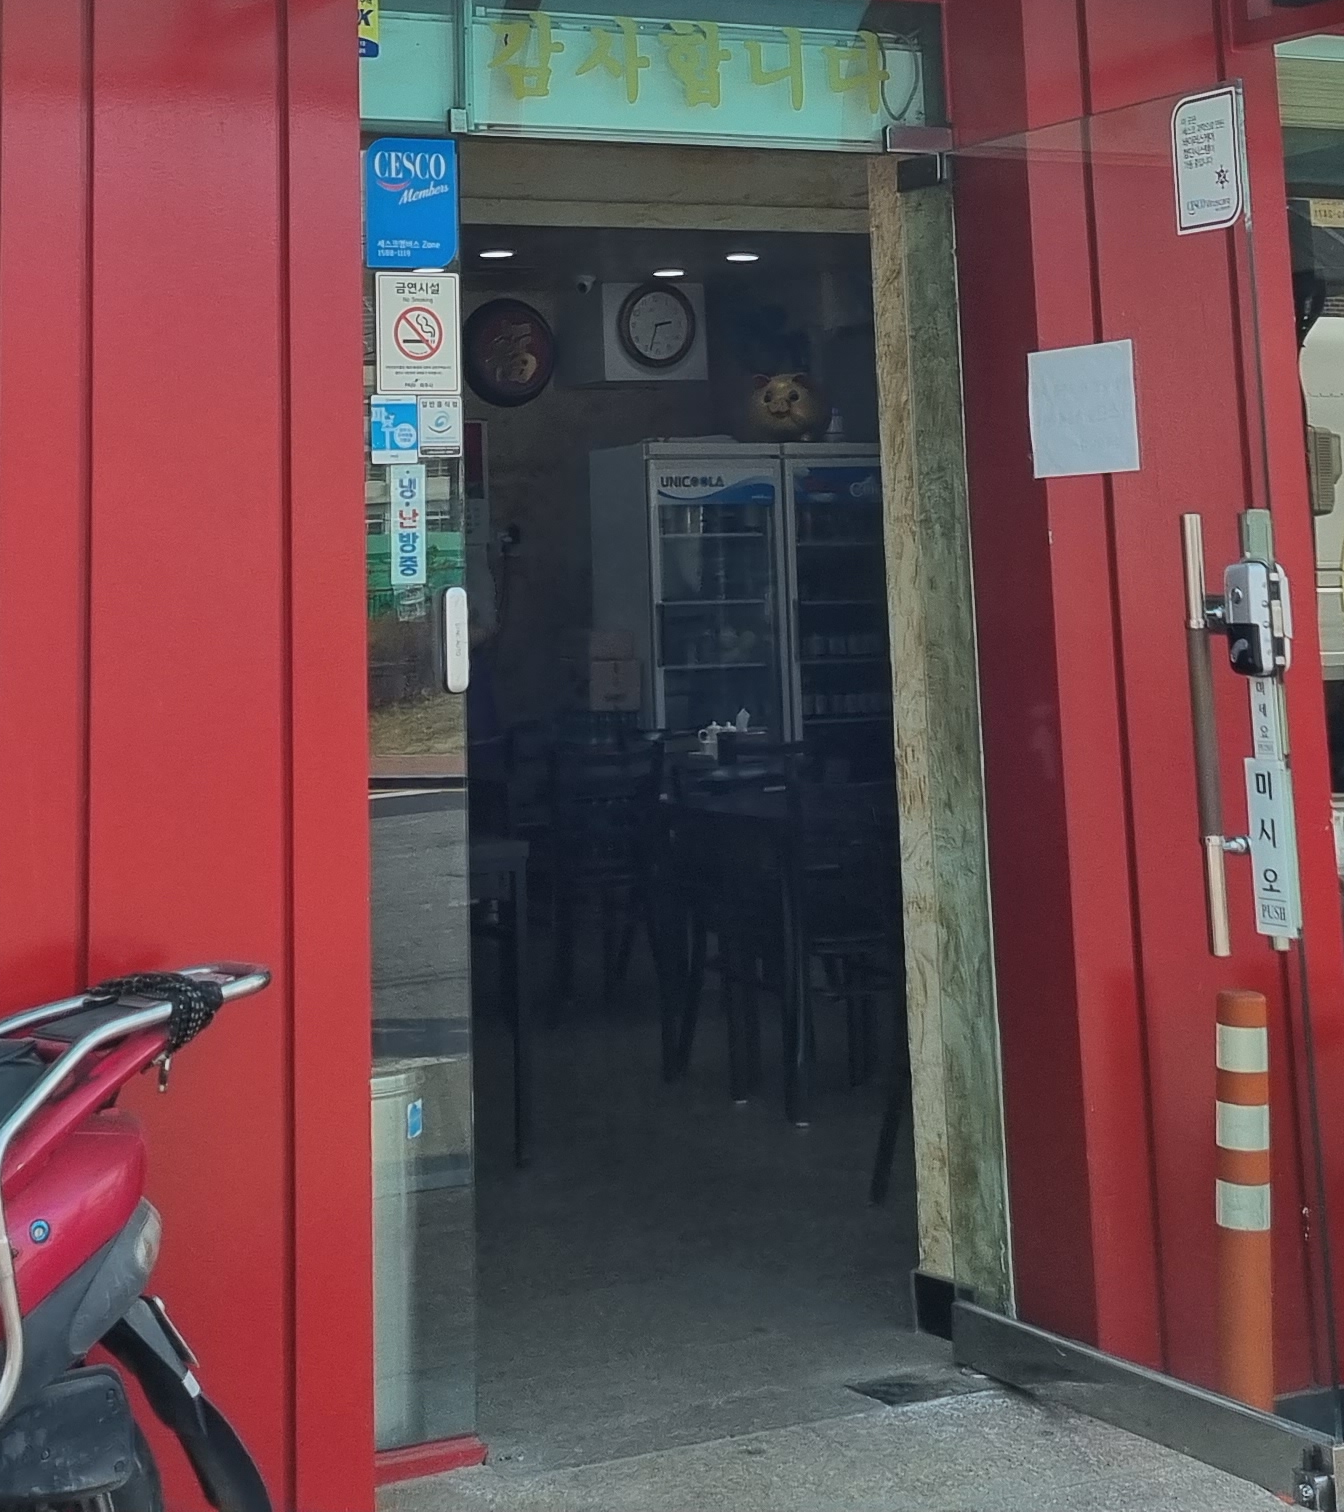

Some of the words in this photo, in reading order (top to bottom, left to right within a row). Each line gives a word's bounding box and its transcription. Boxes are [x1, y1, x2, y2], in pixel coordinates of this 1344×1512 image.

[487, 11, 891, 115] 감사합니다
[374, 150, 446, 180] CESCO
[398, 181, 449, 206] Members
[421, 240, 441, 249] Zone
[395, 281, 440, 295] 금연시설
[1255, 770, 1282, 894] 미시오
[1261, 903, 1287, 922] PUSH
